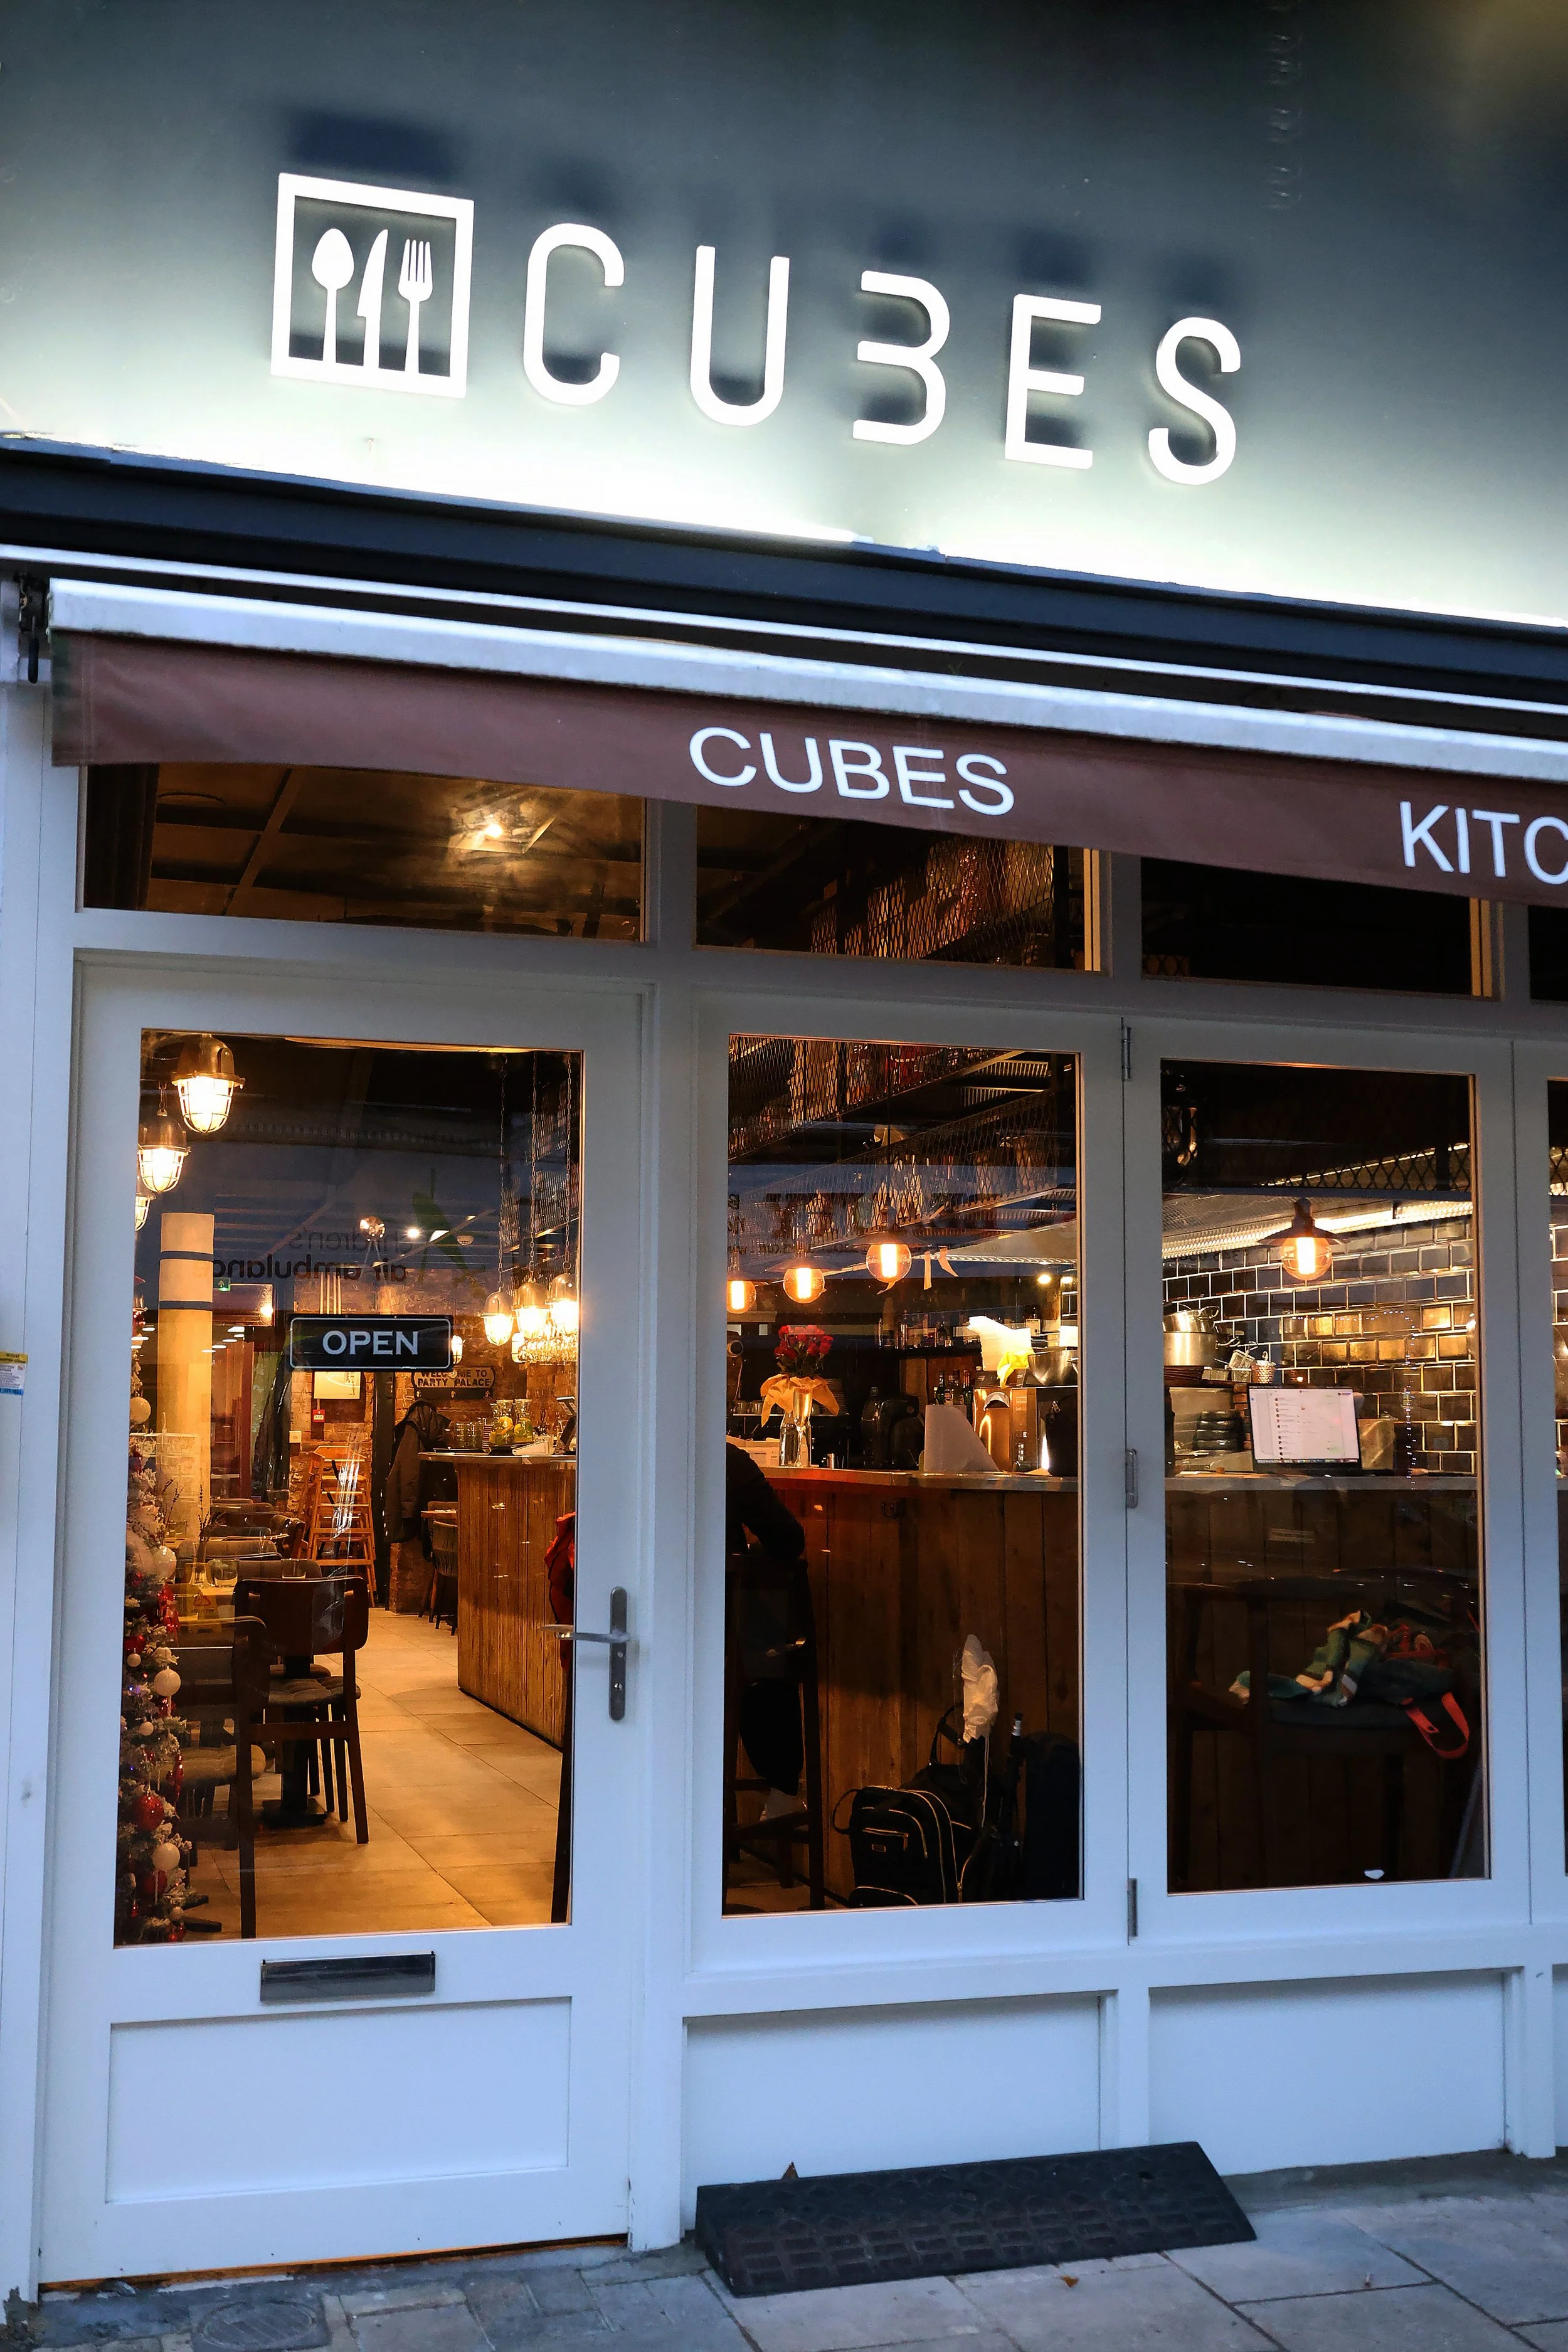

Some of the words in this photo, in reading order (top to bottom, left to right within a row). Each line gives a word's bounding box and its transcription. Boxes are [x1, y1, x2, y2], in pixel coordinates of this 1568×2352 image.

[522, 223, 1241, 485] CUBES
[689, 726, 1015, 815] CUBES
[1399, 800, 1568, 885] KITC
[322, 1330, 418, 1355] OPEN
[418, 1379, 448, 1387] PARTY
[454, 1379, 490, 1387] PALACE
[421, 1369, 472, 1378] WELCME
[475, 1369, 487, 1378] TO
